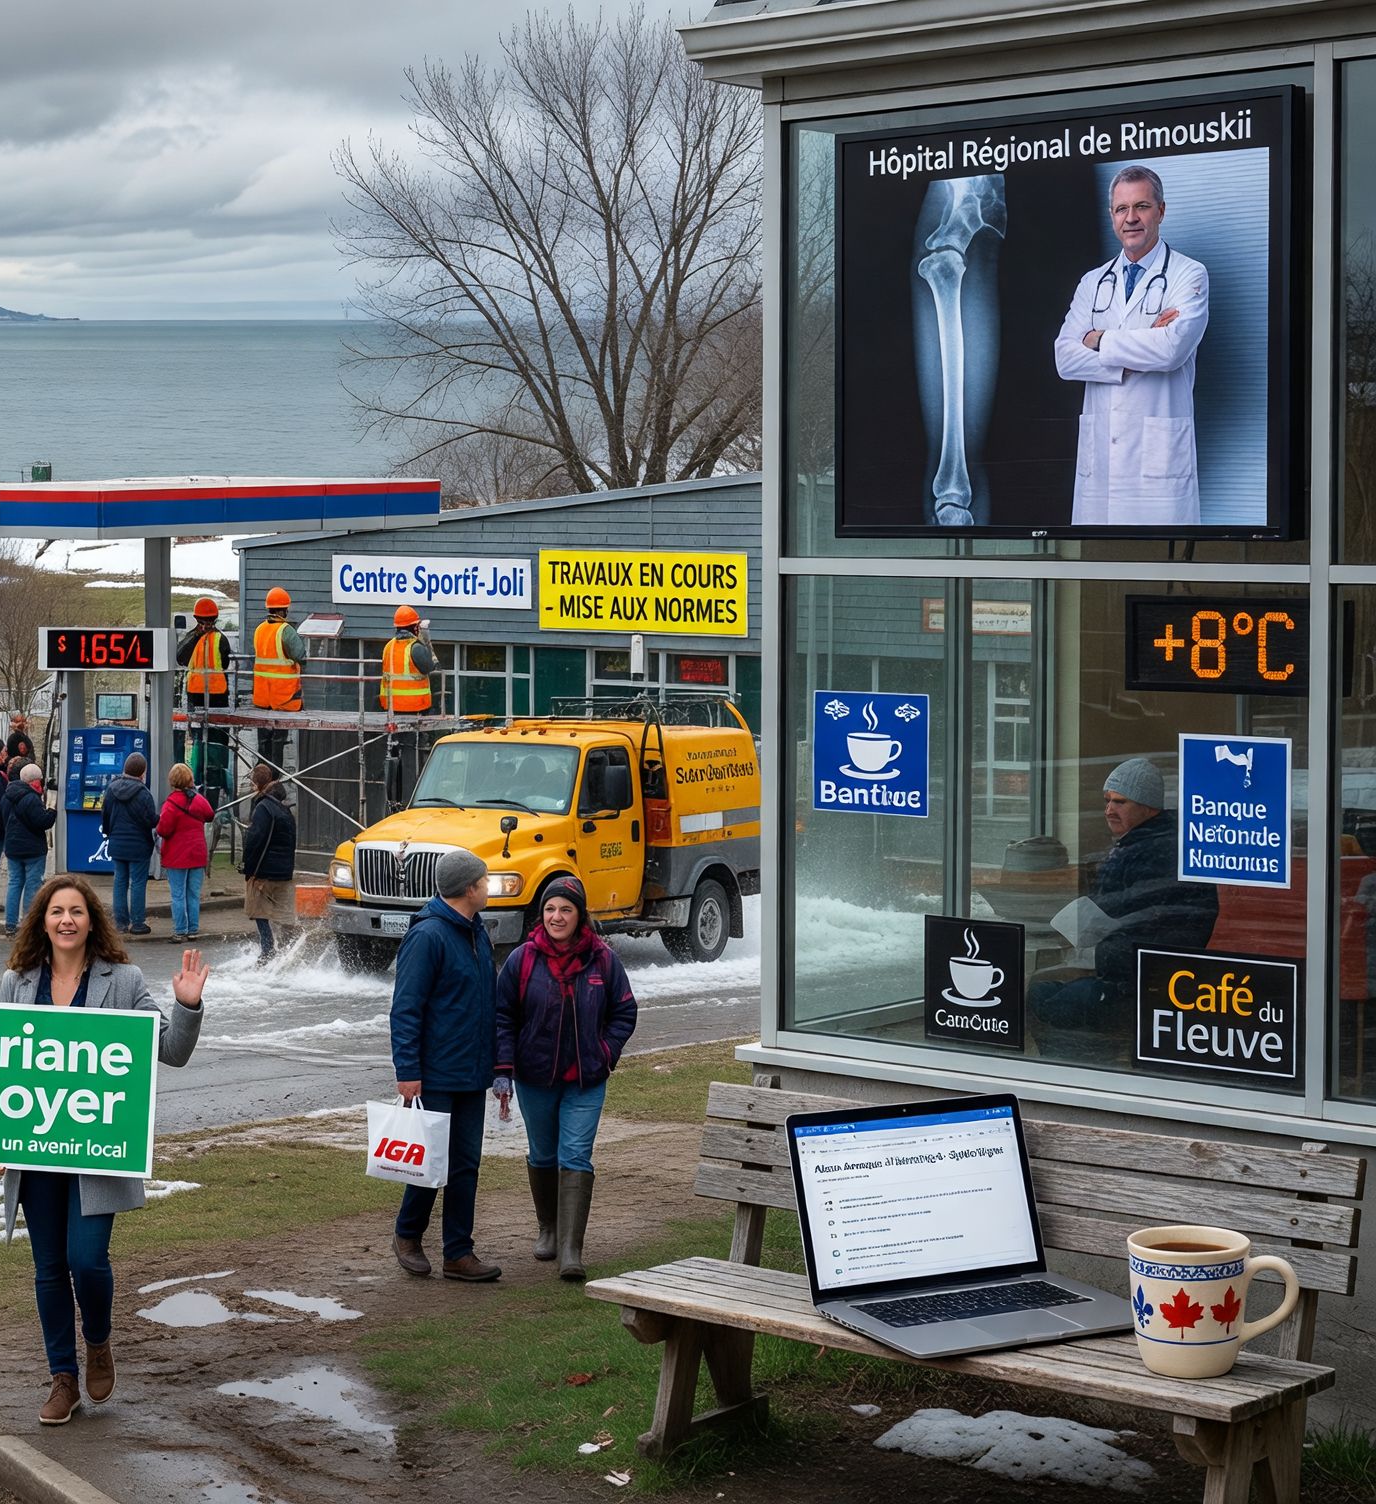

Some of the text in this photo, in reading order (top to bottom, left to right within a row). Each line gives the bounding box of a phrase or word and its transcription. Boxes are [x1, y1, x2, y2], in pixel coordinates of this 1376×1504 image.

[869, 109, 1252, 180] Hôpital Régional de Rimouskii
[339, 564, 408, 593] Centre
[548, 560, 738, 590] TRAVAUX EN COURS
[559, 597, 604, 619] MISE
[609, 596, 648, 621] AUX
[654, 597, 738, 624] NORMES
[1153, 610, 1295, 681] +8°C
[1191, 794, 1267, 820] Banque
[1167, 970, 1284, 1023] Café du
[1152, 1008, 1284, 1063] Fleuve
[1, 1137, 23, 1151] un
[27, 1138, 81, 1155] avenir
[86, 1139, 127, 1158] local
[373, 1137, 426, 1166] IGA
